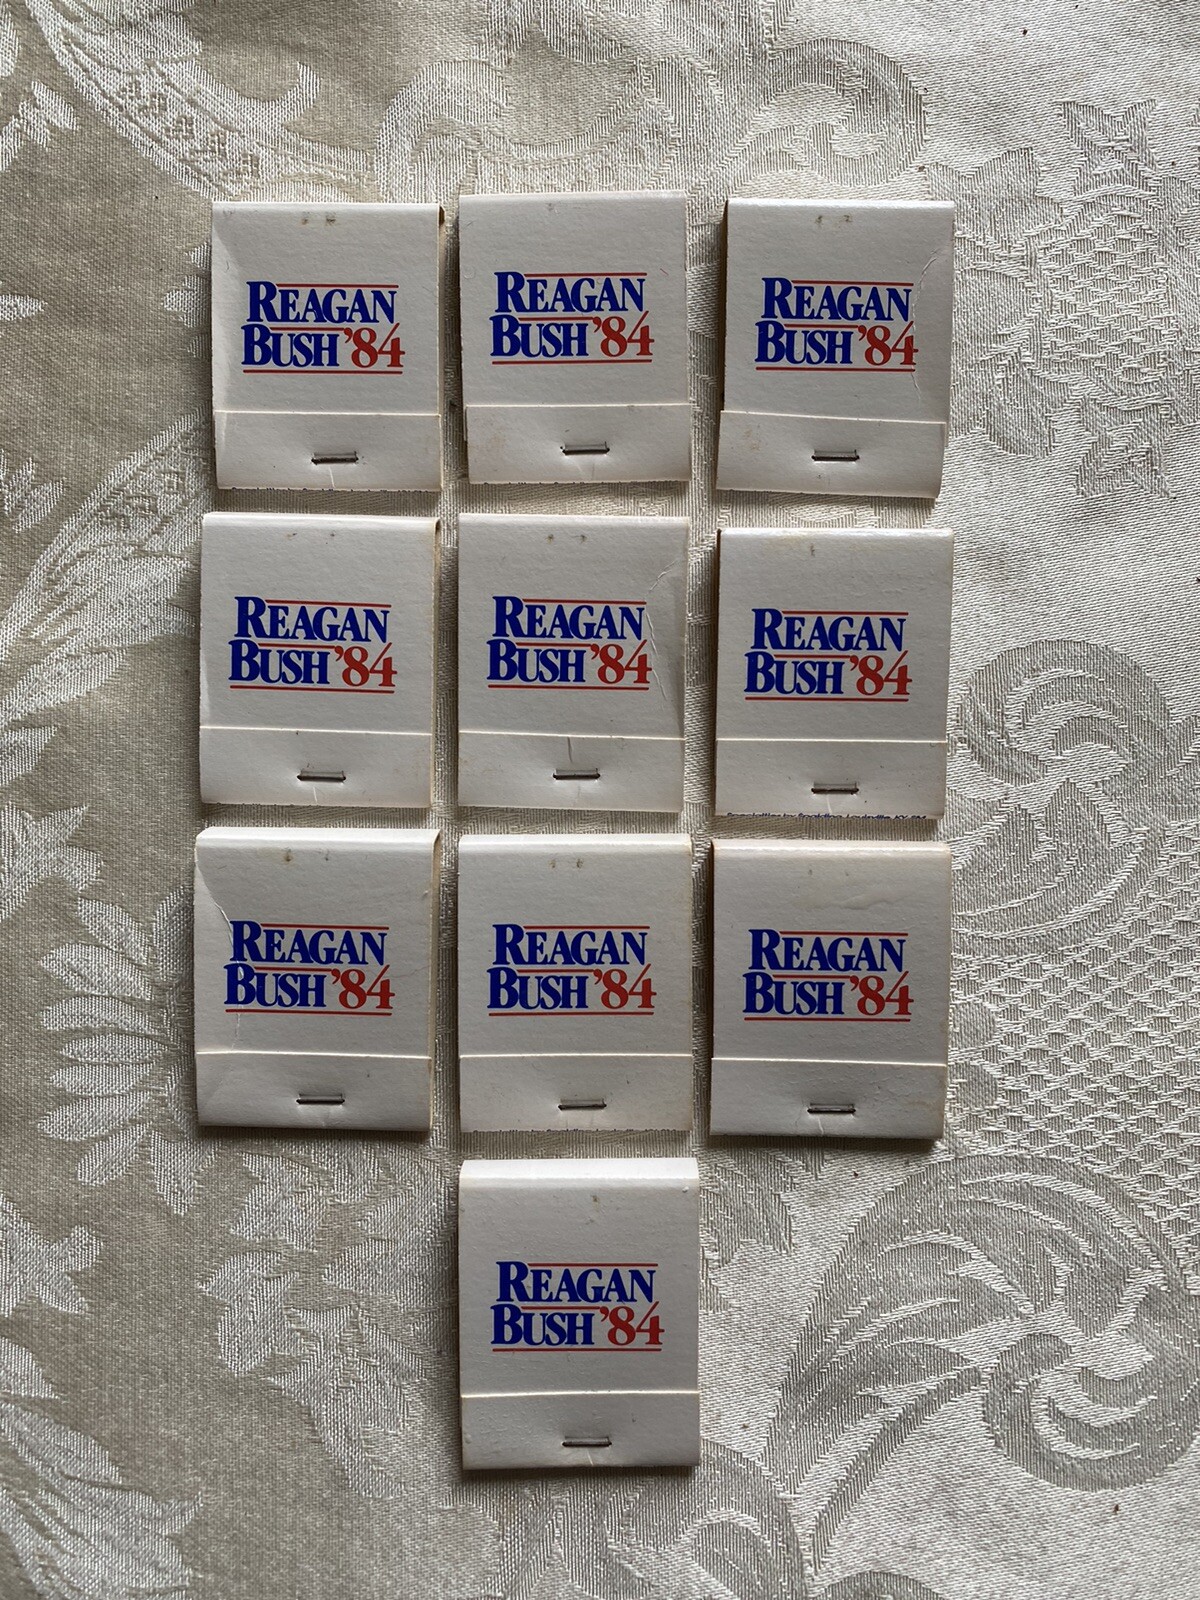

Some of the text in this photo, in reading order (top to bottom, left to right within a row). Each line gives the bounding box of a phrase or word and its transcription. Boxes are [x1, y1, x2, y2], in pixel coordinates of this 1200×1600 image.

[247, 281, 396, 324] REAGAN
[494, 272, 645, 313] REAGAN
[761, 278, 911, 321] REAGAN
[241, 323, 405, 368] BUSH '84
[490, 311, 654, 358] BUSH '84
[755, 320, 919, 366] BUSH '84
[235, 597, 389, 643] REAGAN
[493, 596, 644, 640] REAGAN
[751, 608, 906, 651] REAGAN
[229, 639, 397, 687] BUSH '84
[487, 638, 652, 685] BUSH '84
[744, 650, 912, 696] BUSH '84
[230, 921, 387, 966] REAGAN
[493, 924, 647, 966] REAGAN
[749, 929, 905, 972] REAGAN
[224, 963, 395, 1010] BUSH '84
[487, 964, 656, 1010] BUSH '84
[743, 971, 914, 1016] BUSH '84
[496, 1261, 655, 1303] REAGAN
[491, 1301, 664, 1346] BUSH '84
